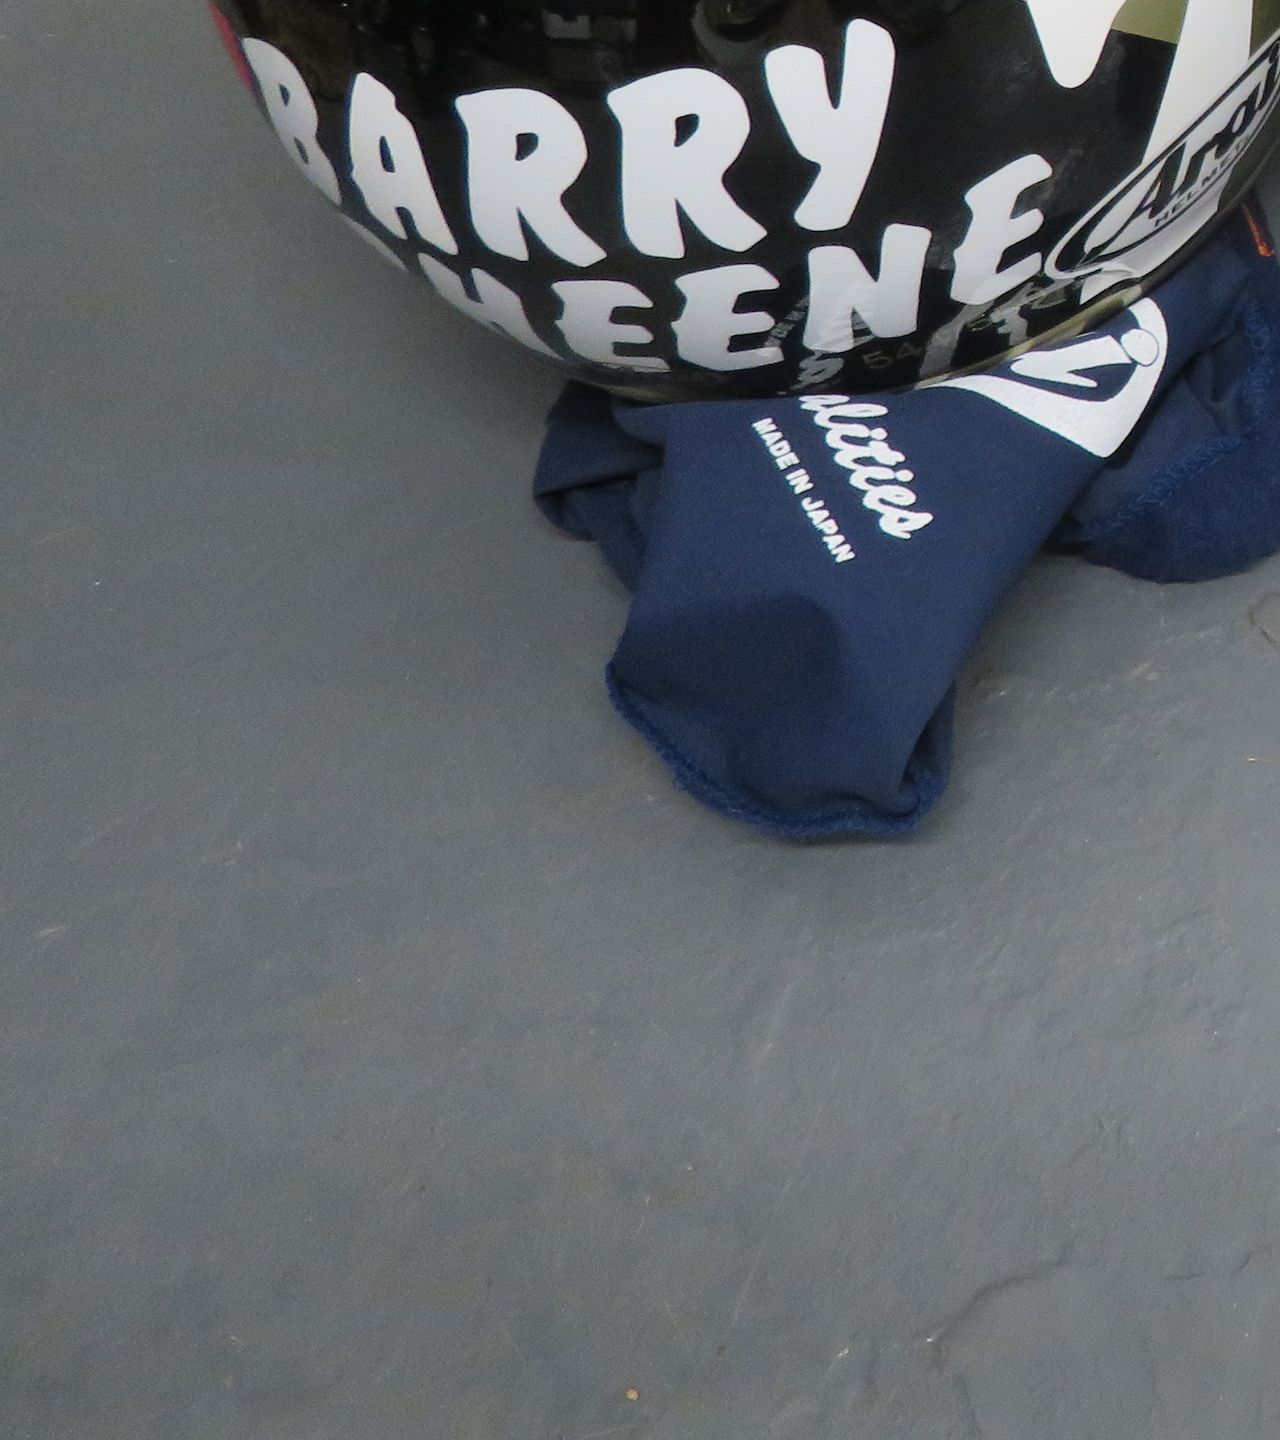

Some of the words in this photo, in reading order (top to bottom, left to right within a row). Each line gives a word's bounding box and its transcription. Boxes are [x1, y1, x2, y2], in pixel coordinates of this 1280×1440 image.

[243, 18, 895, 267] BARRY
[343, 154, 1052, 372] HEENE
[752, 417, 800, 471] MADE
[785, 468, 815, 495] IN
[802, 496, 856, 563] JAPAN
